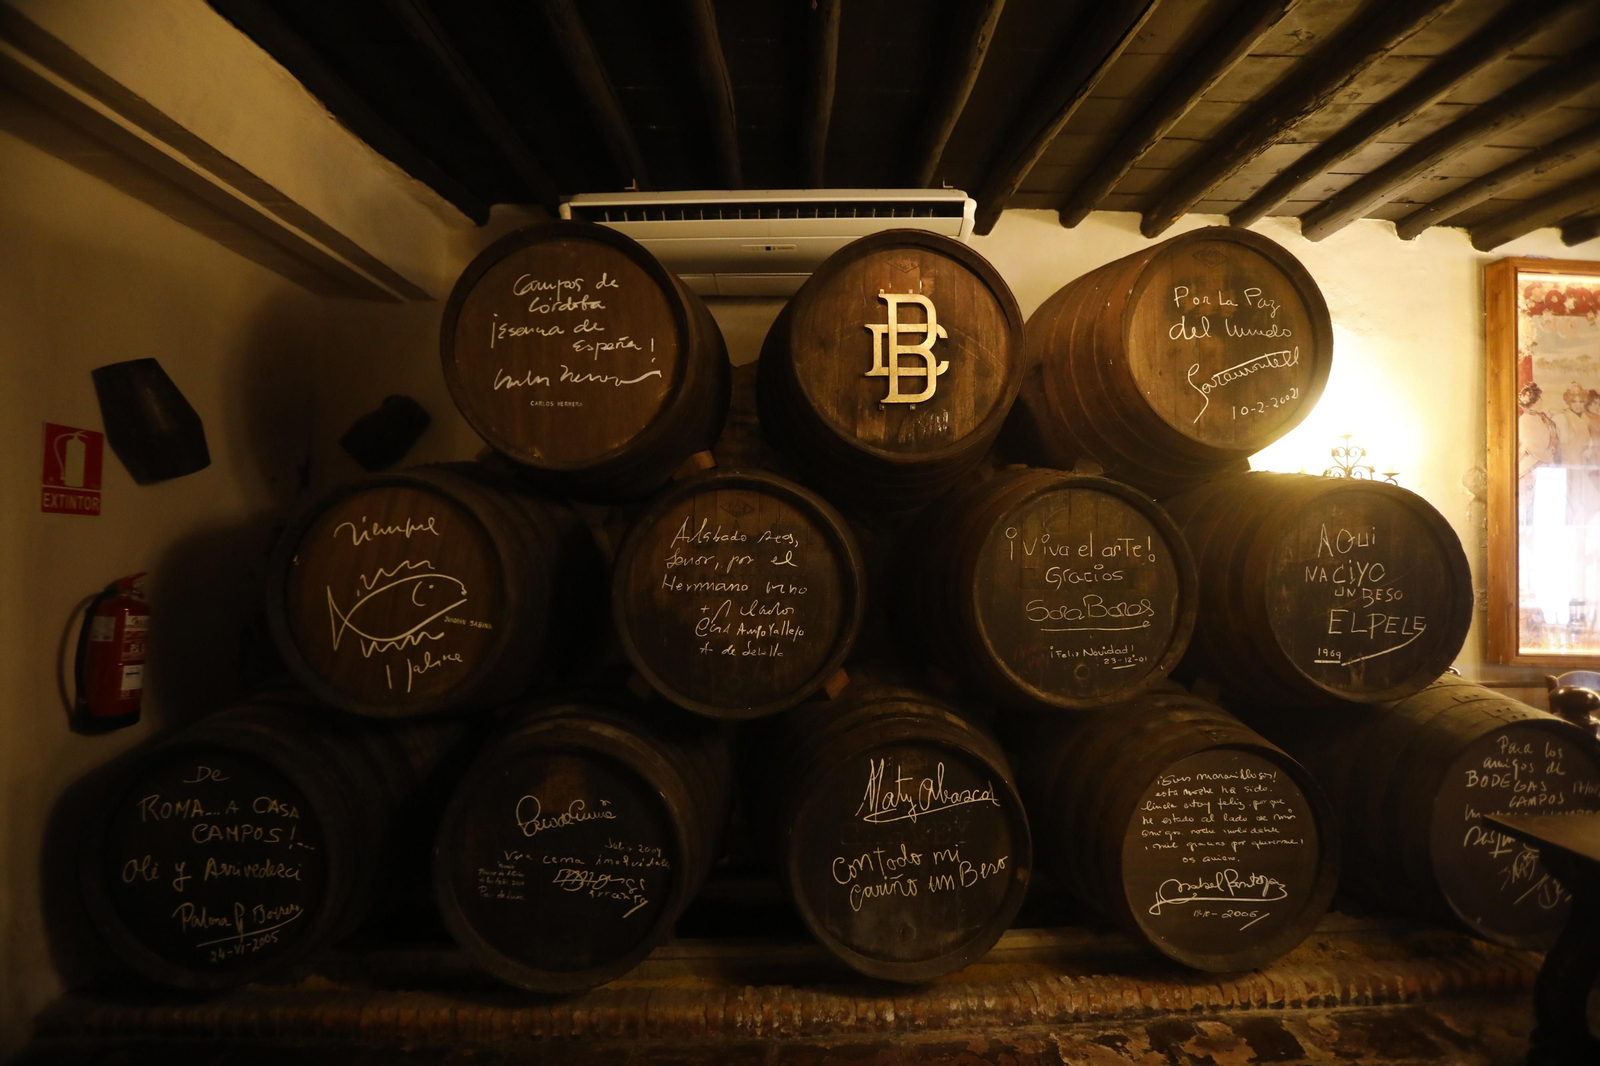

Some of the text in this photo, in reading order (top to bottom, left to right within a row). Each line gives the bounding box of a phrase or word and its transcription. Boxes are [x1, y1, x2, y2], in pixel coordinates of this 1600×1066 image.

[513, 272, 619, 301] Campos de
[1174, 286, 1210, 307] Por
[1244, 288, 1280, 318] Paz
[573, 319, 604, 333] de
[1169, 316, 1211, 339] del
[44, 493, 99, 511] EXTINTOR
[670, 516, 748, 548] Alabado
[1078, 531, 1093, 557] el
[727, 555, 754, 573] por
[770, 550, 798, 567] el
[662, 574, 749, 591] Hermano
[1334, 586, 1403, 608] UN BESO
[469, 620, 492, 629] SABINA
[721, 644, 736, 656] de
[1318, 648, 1341, 659] 1969
[1497, 735, 1563, 758] Para los
[183, 766, 230, 783] De
[1484, 757, 1566, 780] amigos de
[1221, 786, 1236, 794] ha
[225, 800, 239, 814] A
[253, 796, 300, 819] CASA
[1509, 792, 1565, 808] CAMPOS
[1161, 813, 1194, 824] estado
[1201, 814, 1215, 823] al
[1223, 813, 1248, 822] lado
[933, 844, 961, 865] mi
[1231, 840, 1247, 853] por
[543, 855, 585, 865] cena
[928, 874, 955, 893] un
